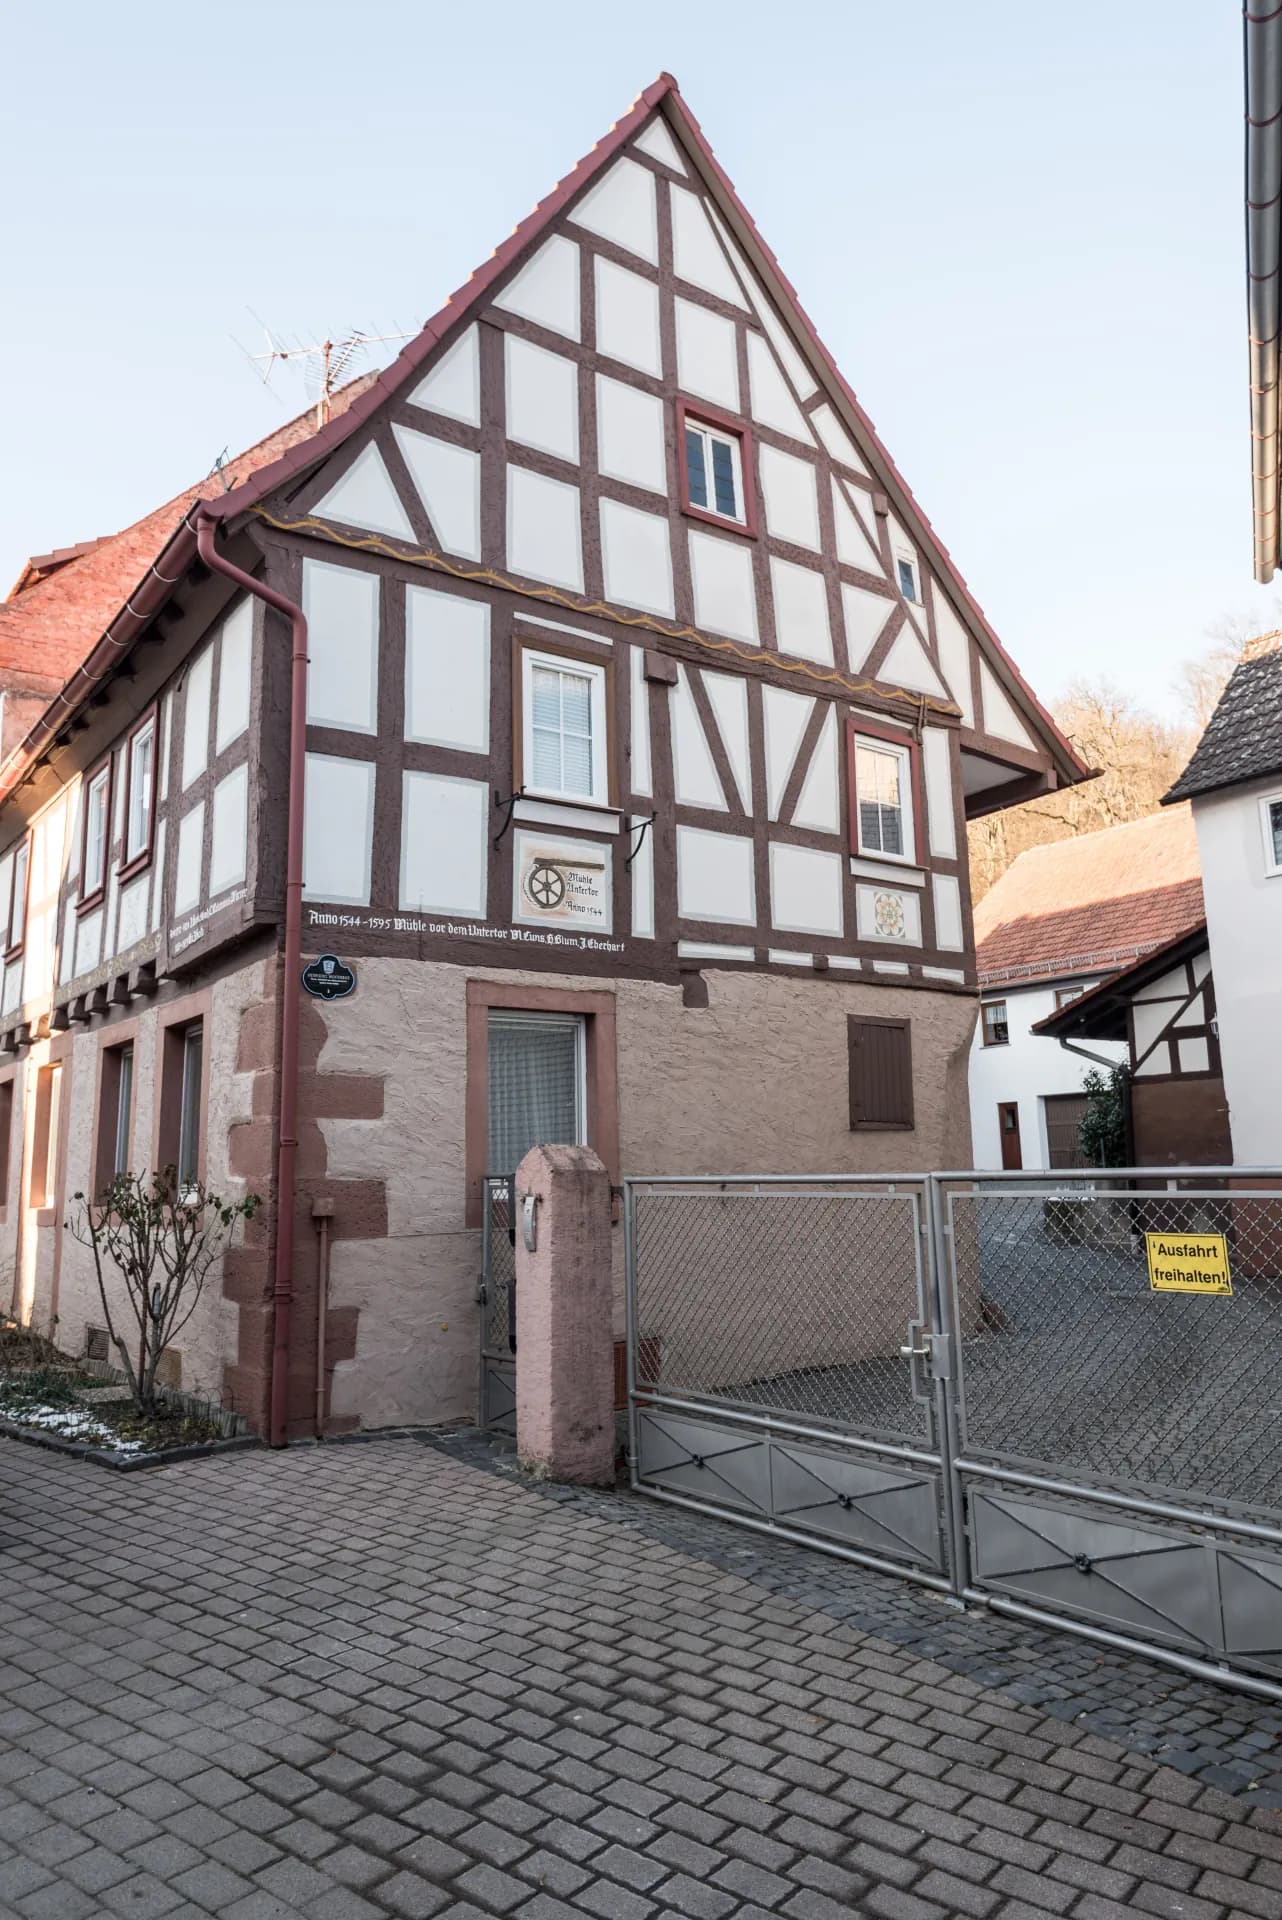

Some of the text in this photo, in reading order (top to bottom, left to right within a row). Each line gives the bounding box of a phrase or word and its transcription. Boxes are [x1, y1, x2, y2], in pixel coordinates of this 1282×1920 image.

[566, 900, 586, 913] Anno
[308, 909, 338, 925] Anno
[393, 918, 427, 932] Mühle
[429, 922, 446, 934] vor
[447, 922, 467, 935] dem
[468, 924, 508, 939] Untertor
[1158, 1243, 1218, 1258] Ausfahrt
[1154, 1267, 1226, 1284] freihalten!
